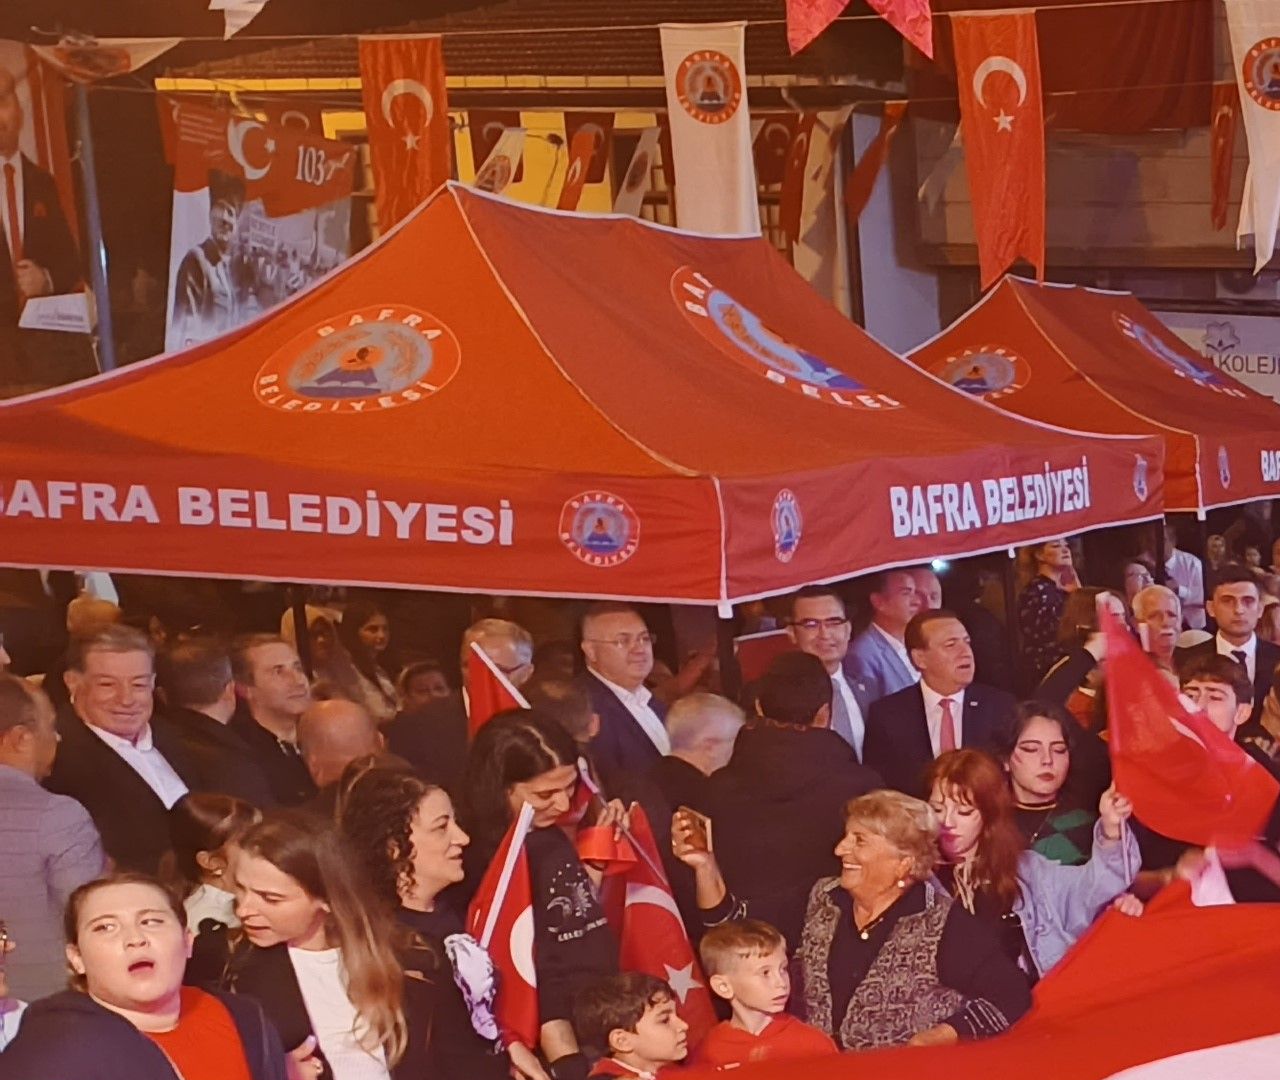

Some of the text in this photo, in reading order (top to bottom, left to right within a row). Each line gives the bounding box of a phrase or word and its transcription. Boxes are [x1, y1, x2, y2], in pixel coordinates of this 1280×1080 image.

[0, 479, 514, 545] AFRA BELEDİYESİ
[890, 482, 982, 538] BAFRA
[982, 455, 1091, 527] BELEDİYESİ
